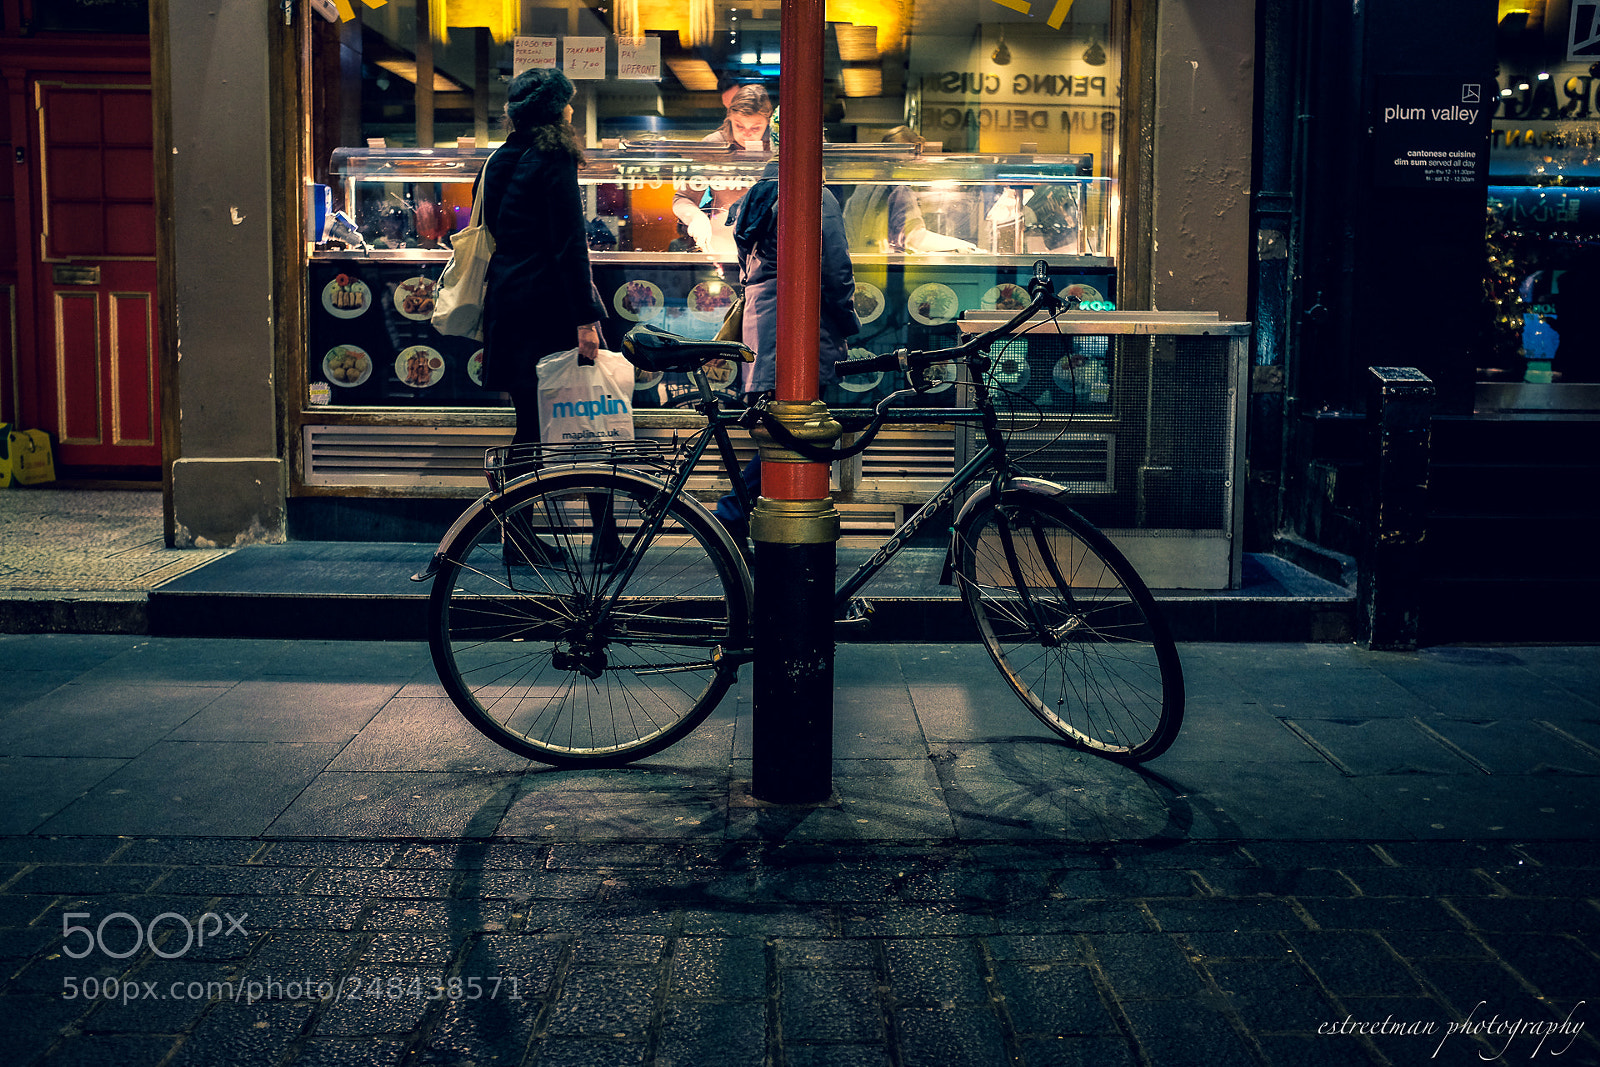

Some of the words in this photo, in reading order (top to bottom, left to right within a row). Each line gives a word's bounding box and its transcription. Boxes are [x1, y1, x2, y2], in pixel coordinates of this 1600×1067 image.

[621, 50, 638, 59] PAY
[620, 64, 658, 76] UPFRONT
[1384, 104, 1426, 123] plum
[1431, 105, 1479, 125] valley
[1407, 150, 1447, 158] cantonese
[1448, 150, 1476, 158] cuisine
[1394, 158, 1409, 166] dim
[1428, 159, 1452, 167] served
[1453, 159, 1461, 167] all
[1462, 160, 1476, 168] day
[552, 394, 628, 421] maplin
[872, 537, 901, 566] GO
[904, 481, 956, 539] SPORT
